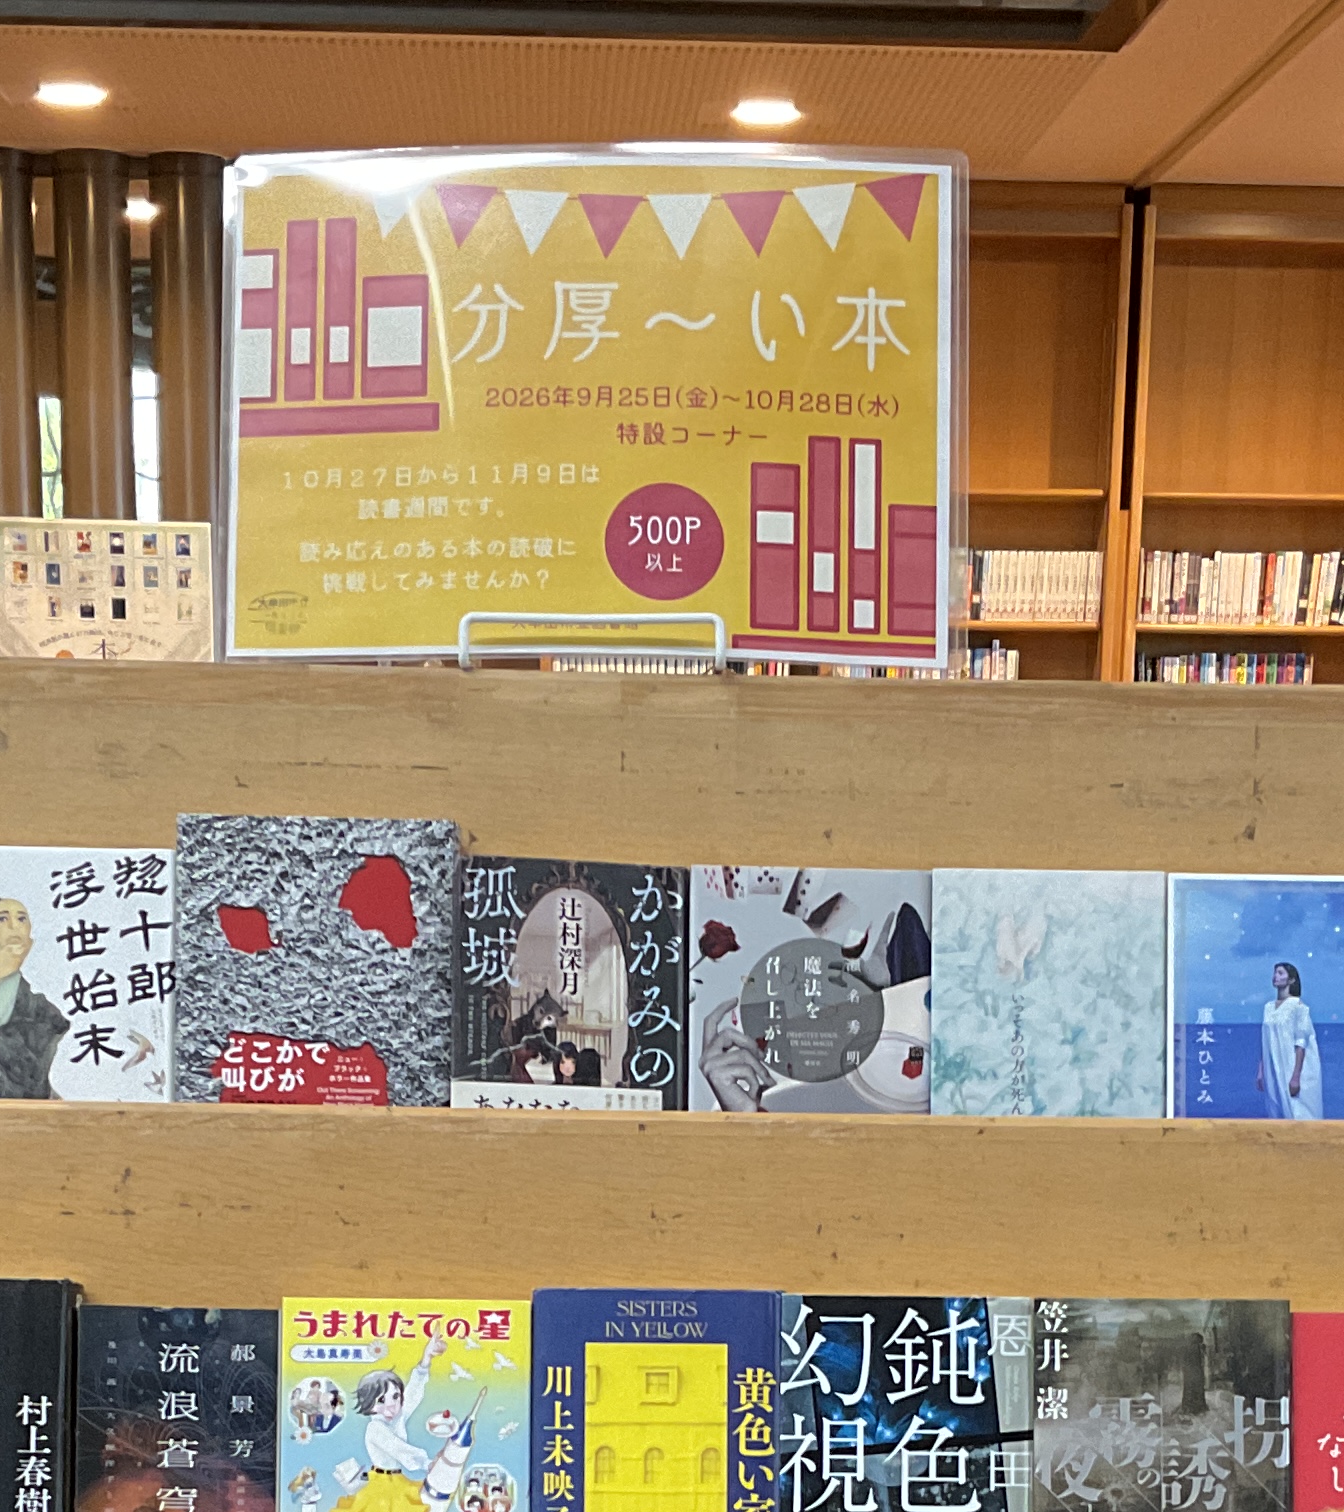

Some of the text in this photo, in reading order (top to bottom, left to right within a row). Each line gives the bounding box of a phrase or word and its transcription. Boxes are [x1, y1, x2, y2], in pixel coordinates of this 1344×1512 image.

[615, 422, 769, 448] 特設コーナー
[357, 496, 506, 521] 読書週間です。
[627, 514, 703, 549] 500P
[298, 536, 578, 562] 読み応えのある本の読破に
[644, 552, 684, 574] 以上
[113, 852, 177, 1004] 惣十郎
[461, 865, 528, 988] 孤城
[48, 860, 124, 1067] 浮世始末
[558, 897, 583, 996] 辻村深月
[628, 873, 684, 1088] かがみの
[803, 955, 822, 1020] 魔法を
[223, 1037, 331, 1065] どこかで
[1195, 1006, 1215, 1106] 藤本ひとみ
[221, 1066, 305, 1093] 叫びが
[292, 1309, 512, 1342] うまれたての星
[615, 1301, 699, 1317] SISTERS
[604, 1320, 709, 1339] IN YELLOW
[987, 1312, 1034, 1493] 恩田
